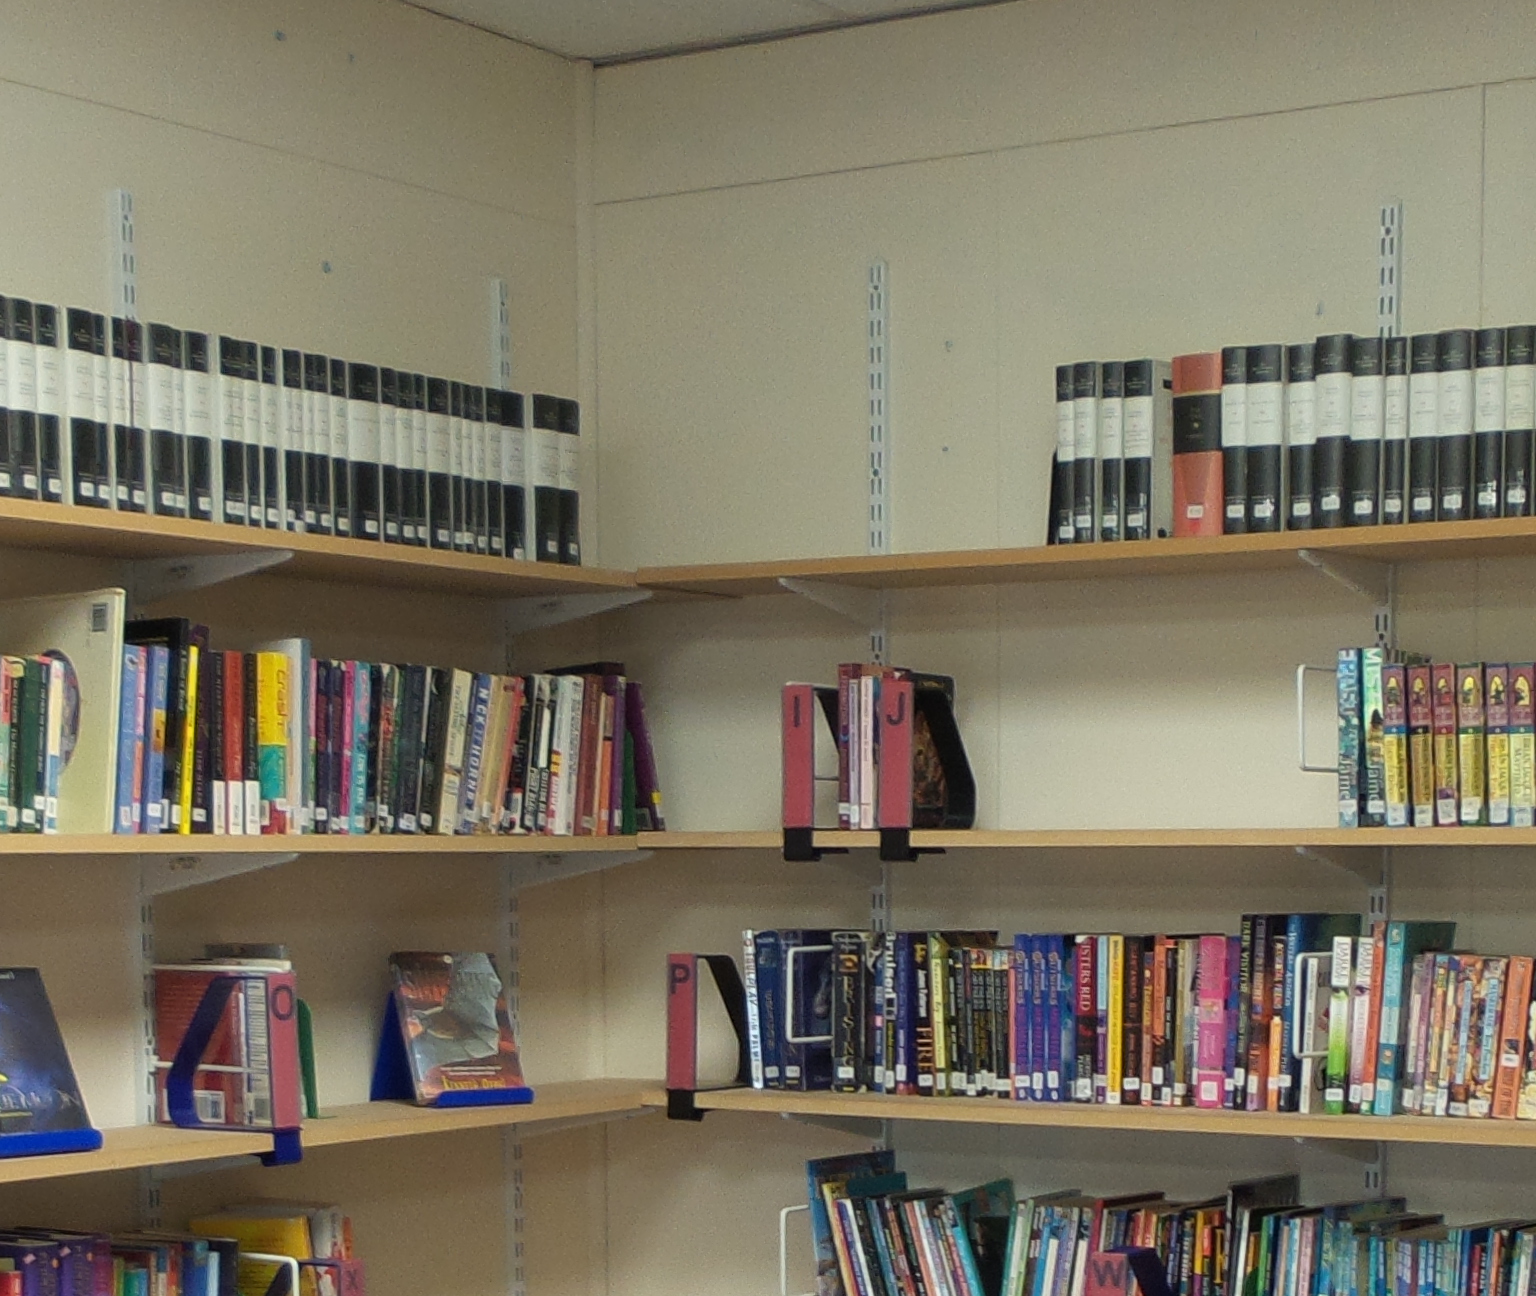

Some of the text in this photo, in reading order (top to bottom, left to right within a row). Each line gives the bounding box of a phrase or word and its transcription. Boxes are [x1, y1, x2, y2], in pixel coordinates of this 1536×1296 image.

[886, 690, 906, 726] J
[1240, 921, 1252, 994] DARK VISITOR
[669, 963, 691, 995] P
[1080, 944, 1093, 1012] ISTERS RED
[271, 984, 294, 1021] O
[915, 1026, 934, 1072] FIRE
[346, 1269, 358, 1290] X
[1093, 1258, 1126, 1288] W
